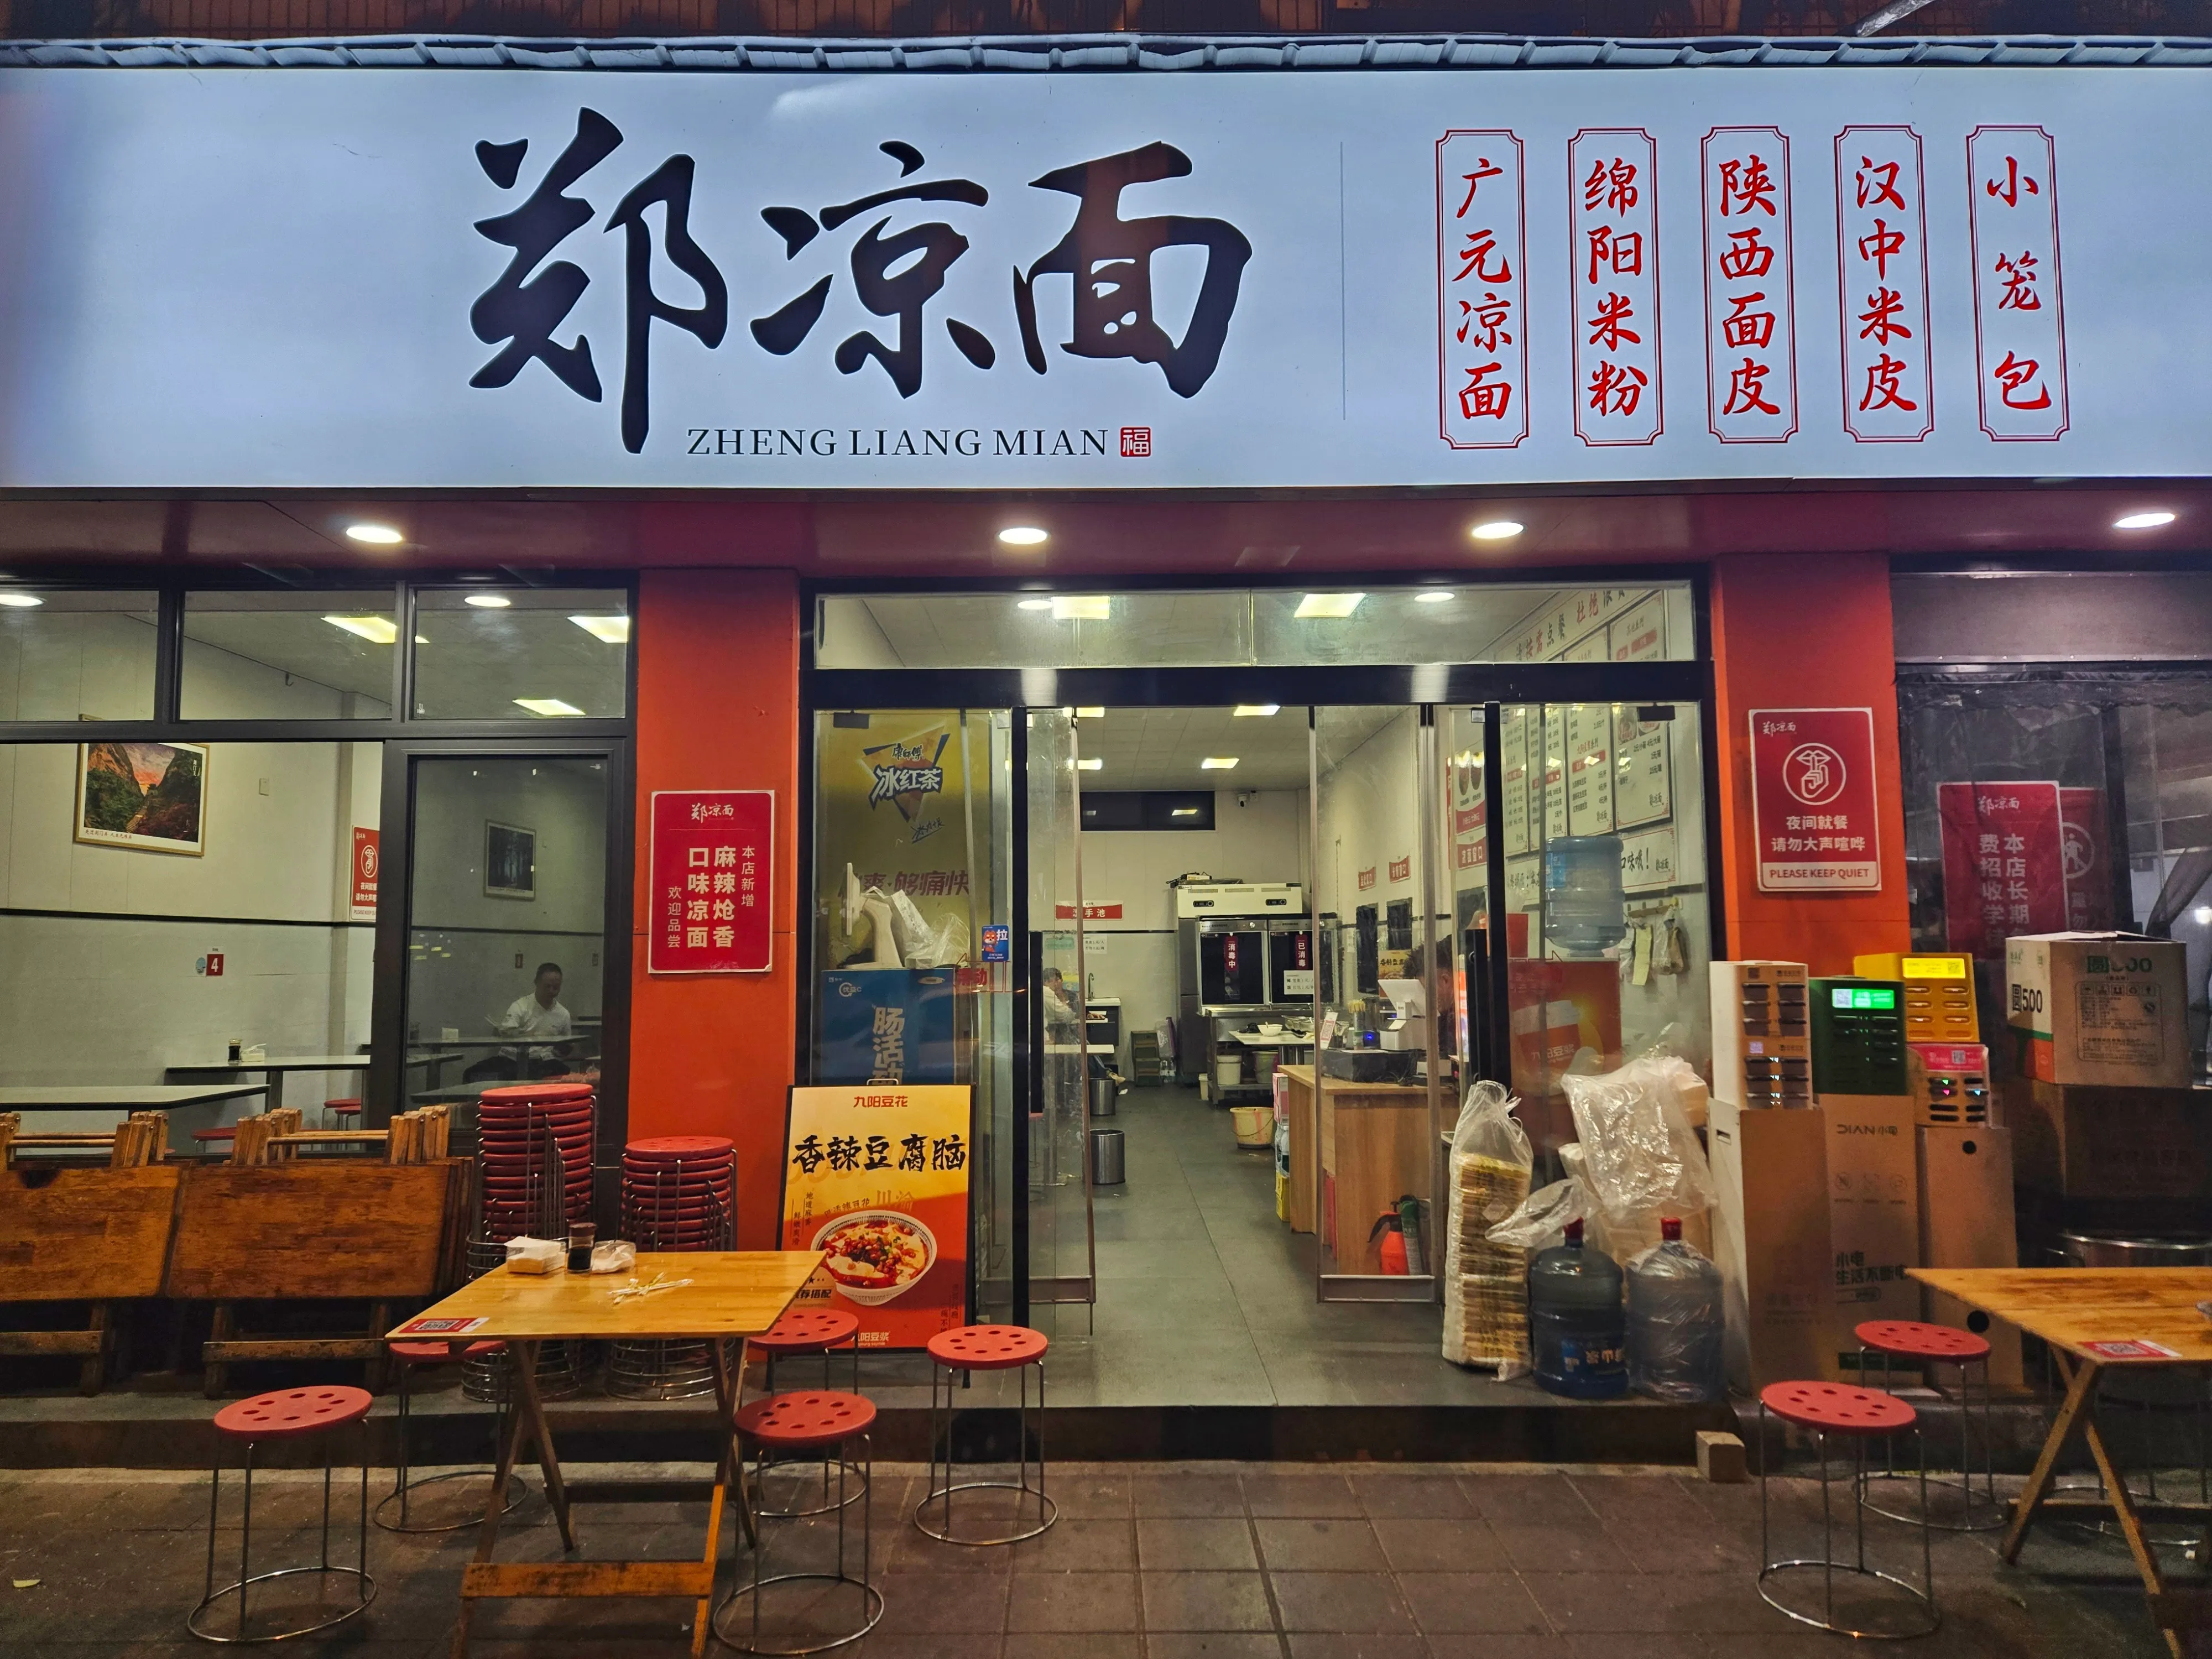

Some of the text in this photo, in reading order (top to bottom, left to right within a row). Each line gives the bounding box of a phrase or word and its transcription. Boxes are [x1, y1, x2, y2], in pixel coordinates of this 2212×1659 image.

[469, 107, 1252, 454] 郑凉面
[1452, 158, 1512, 420] 广元凉面
[1583, 157, 1648, 418] 绵阳米粉
[1718, 155, 1781, 416] 陕西面皮
[1855, 155, 1918, 413] 汉中米皮
[1987, 156, 2052, 411] 小笼包
[687, 428, 1108, 457] ZHENG LIANG MIAN
[1120, 427, 1151, 457] 福
[1762, 721, 1797, 737] 郑凉面
[872, 766, 941, 802] 冰红茶
[691, 802, 734, 823] 郑凉面
[1978, 796, 2020, 816] 郑凉面
[1786, 815, 1849, 831] 夜间就餐
[1771, 836, 1866, 853] 请勿大声喧哗
[741, 846, 755, 907] 本店新增
[1770, 868, 1870, 880] PLEASE KEEP QUIET
[686, 847, 710, 948] 口味凉面
[713, 846, 737, 948] 麻辣炝香
[667, 886, 682, 948] 欢迎品尝
[997, 929, 1008, 941] 拉
[211, 958, 218, 972] 4
[1228, 943, 1236, 968] 消毒中
[2087, 956, 2153, 973] 圆00
[854, 1095, 909, 1108] 九阳豆花
[792, 1133, 967, 1174] 香辣豆腐脑
